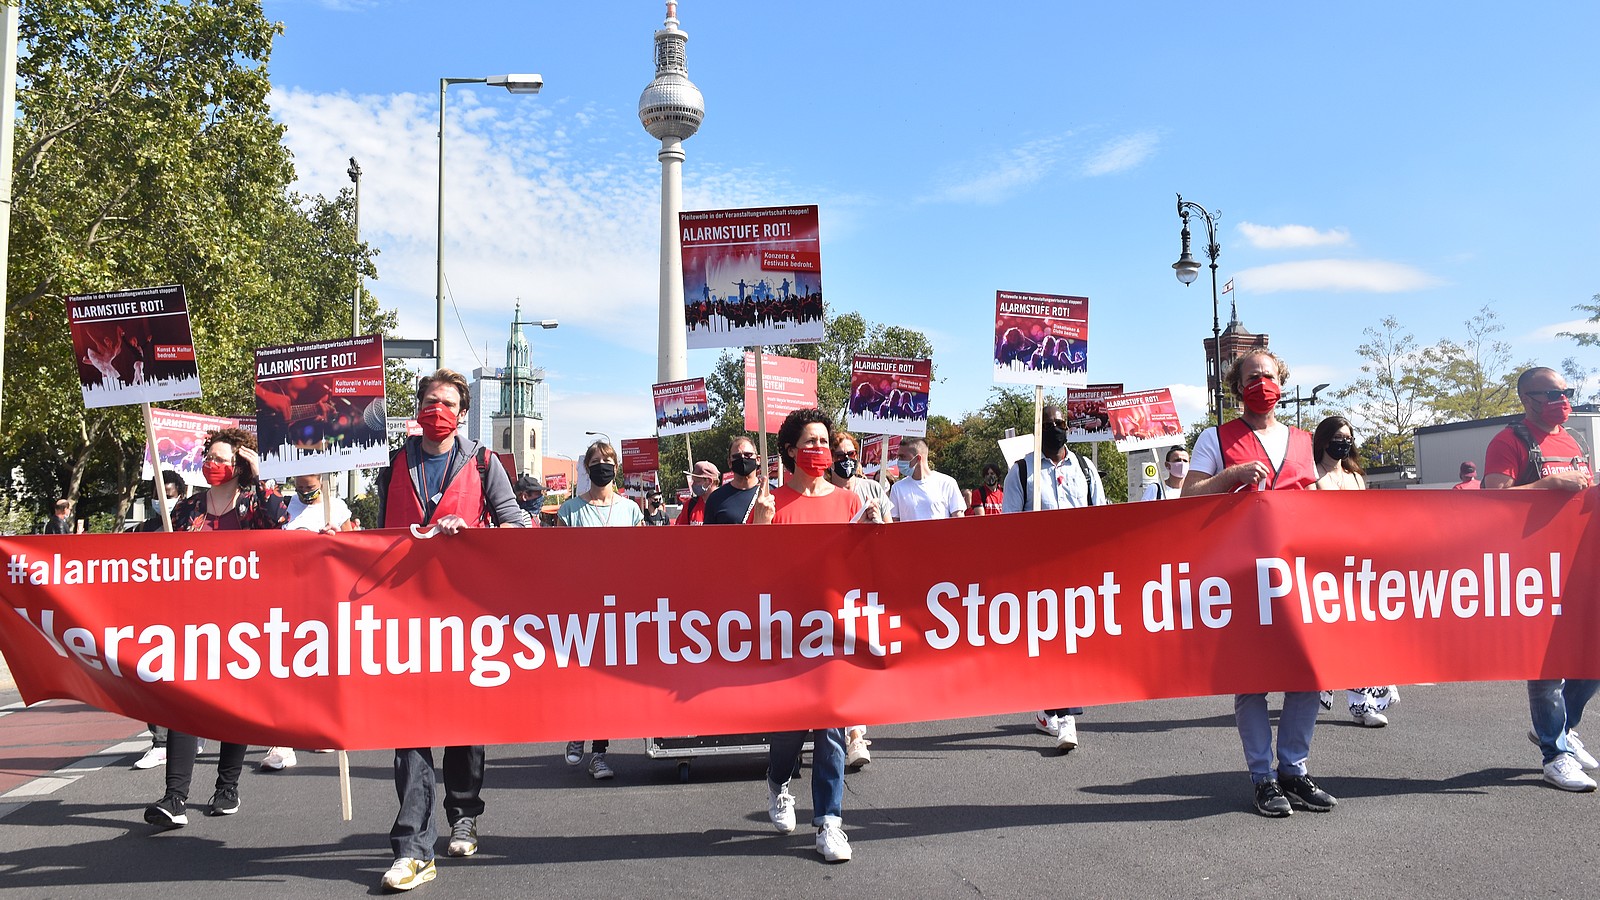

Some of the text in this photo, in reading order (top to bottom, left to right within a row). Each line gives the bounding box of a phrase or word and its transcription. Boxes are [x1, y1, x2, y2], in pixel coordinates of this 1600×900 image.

[725, 210, 786, 219] Veranstaltungswirtschaft
[788, 208, 809, 216] stoppen!
[683, 223, 790, 242] ALARMSTUFE ROT!
[73, 300, 164, 318] ALARMSTUFE ROT!
[1000, 303, 1070, 317] ALARMSTUFE ROT!
[296, 340, 353, 352] Veranstaltungswirtschaft
[354, 338, 374, 346] stoppen!
[257, 352, 357, 376] ALARMSTUFE ROT!
[800, 361, 815, 374] 3/6
[855, 361, 914, 373] ALARMSTUFE ROT!
[654, 386, 683, 396] ALARMSTUFE
[1107, 398, 1144, 408] ALARMSTUFE
[153, 417, 220, 433] ALARMSTUFE ROT!
[387, 422, 406, 430] tgarte
[7, 550, 260, 585] #alarmstuferot
[14, 552, 1562, 688] Veranstaltungswirtschaft: Stoppt die Pleitewelle!
